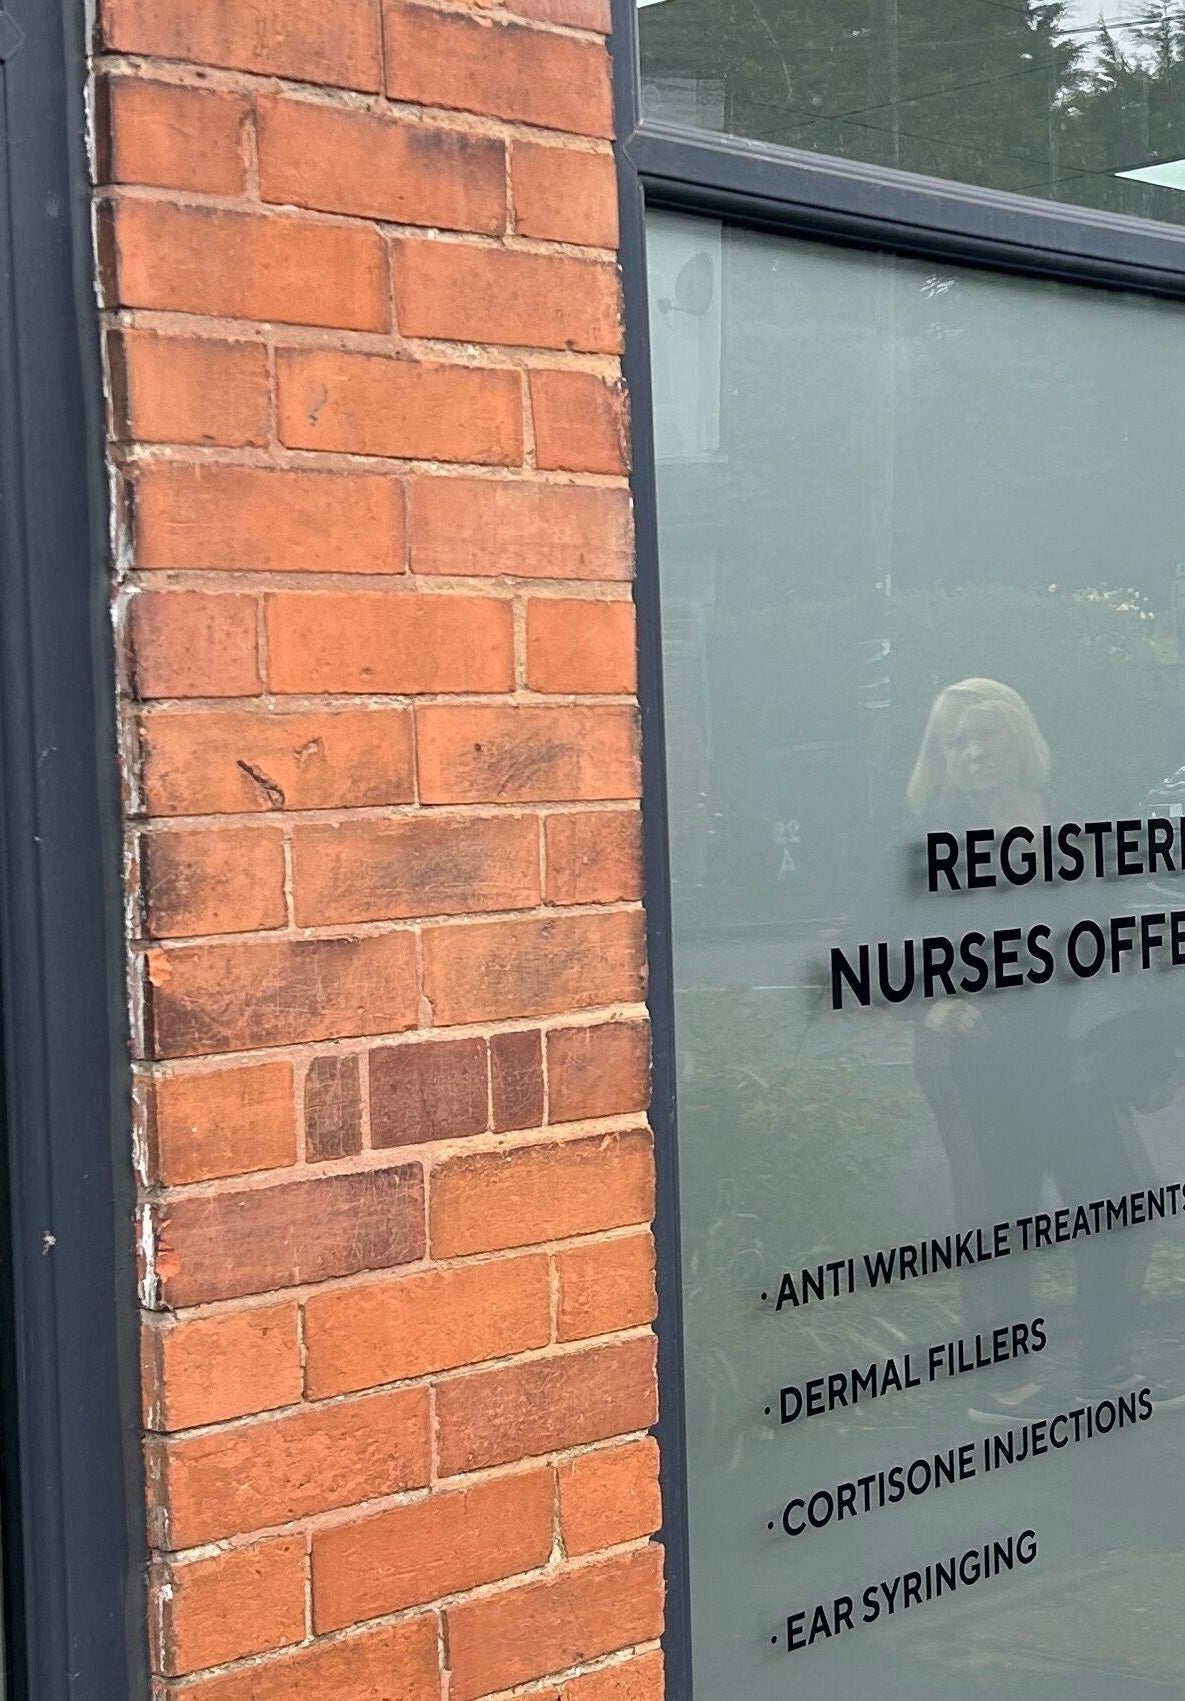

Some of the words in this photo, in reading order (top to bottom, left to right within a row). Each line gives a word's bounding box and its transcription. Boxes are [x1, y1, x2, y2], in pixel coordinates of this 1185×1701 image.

[831, 925, 1053, 1009] NURSES
[776, 1259, 854, 1311] ANTI
[864, 1223, 1010, 1287] WRINKLE
[781, 1355, 920, 1424] DERMAL
[929, 1318, 1046, 1381] FILLERS
[783, 1444, 975, 1536] CORTISONE
[985, 1389, 1152, 1471] INJECTIONS
[787, 1597, 854, 1652] EAR
[863, 1530, 1036, 1622] SYRINGING
